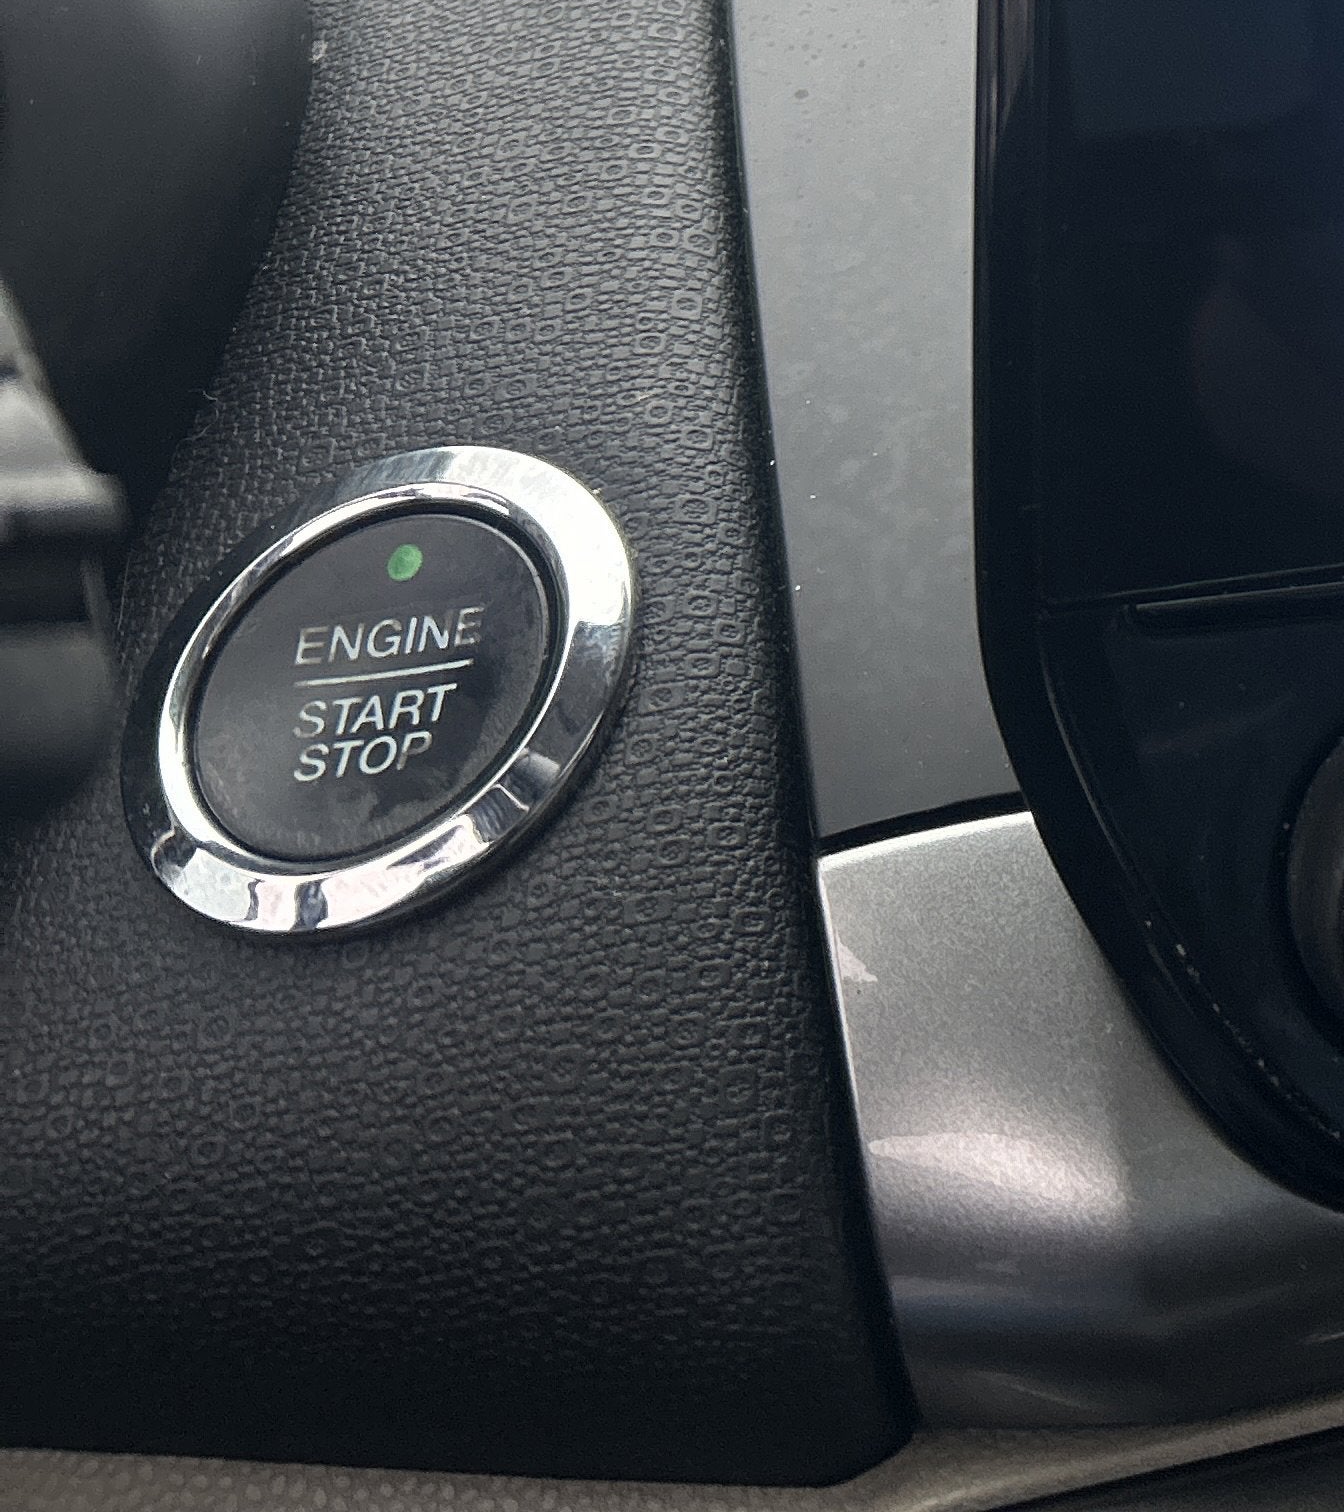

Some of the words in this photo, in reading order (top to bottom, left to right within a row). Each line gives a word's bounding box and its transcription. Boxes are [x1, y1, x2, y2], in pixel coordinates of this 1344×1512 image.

[294, 606, 486, 666] ENGINE
[294, 683, 458, 740] START
[294, 731, 433, 782] STOP
